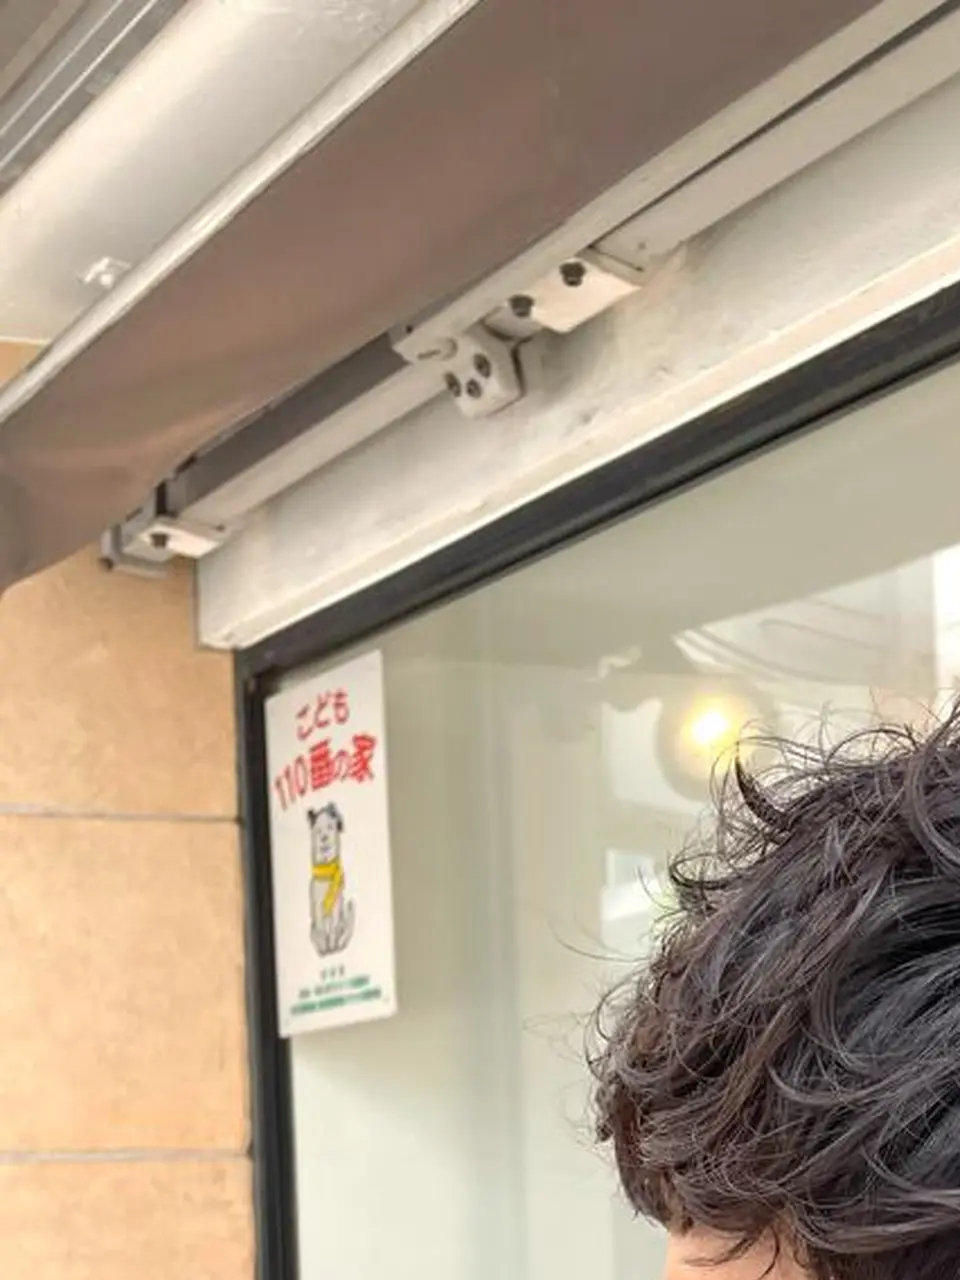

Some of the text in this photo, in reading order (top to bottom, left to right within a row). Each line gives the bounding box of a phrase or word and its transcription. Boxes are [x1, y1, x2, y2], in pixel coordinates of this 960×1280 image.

[296, 688, 349, 740] こども
[275, 733, 376, 811] 110番の家
